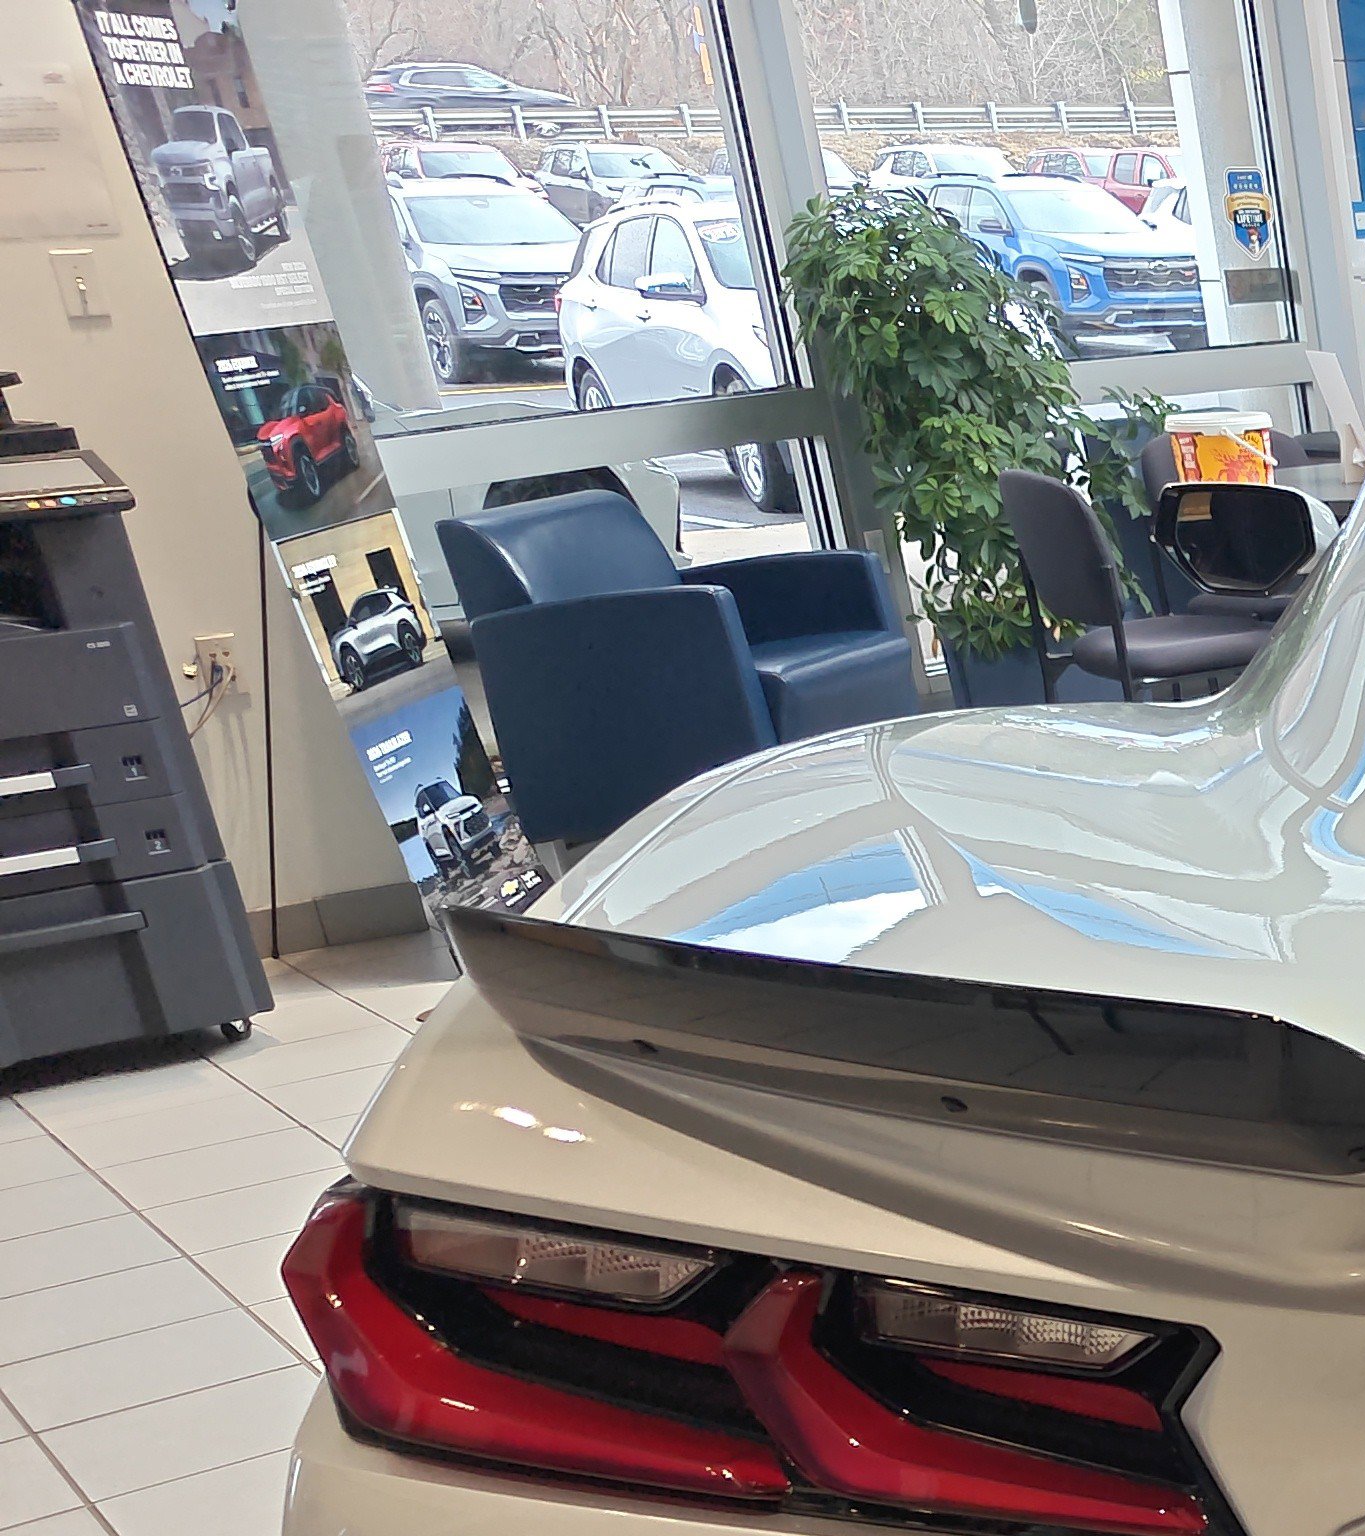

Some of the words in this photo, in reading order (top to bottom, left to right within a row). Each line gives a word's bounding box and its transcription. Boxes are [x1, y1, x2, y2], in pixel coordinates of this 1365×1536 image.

[94, 10, 112, 33] IT
[109, 12, 135, 36] ALL
[131, 14, 179, 41] COMES
[102, 36, 170, 63] TOGETHER
[166, 42, 185, 65] IN
[113, 61, 127, 85] A
[122, 62, 195, 89] CHEVROLET
